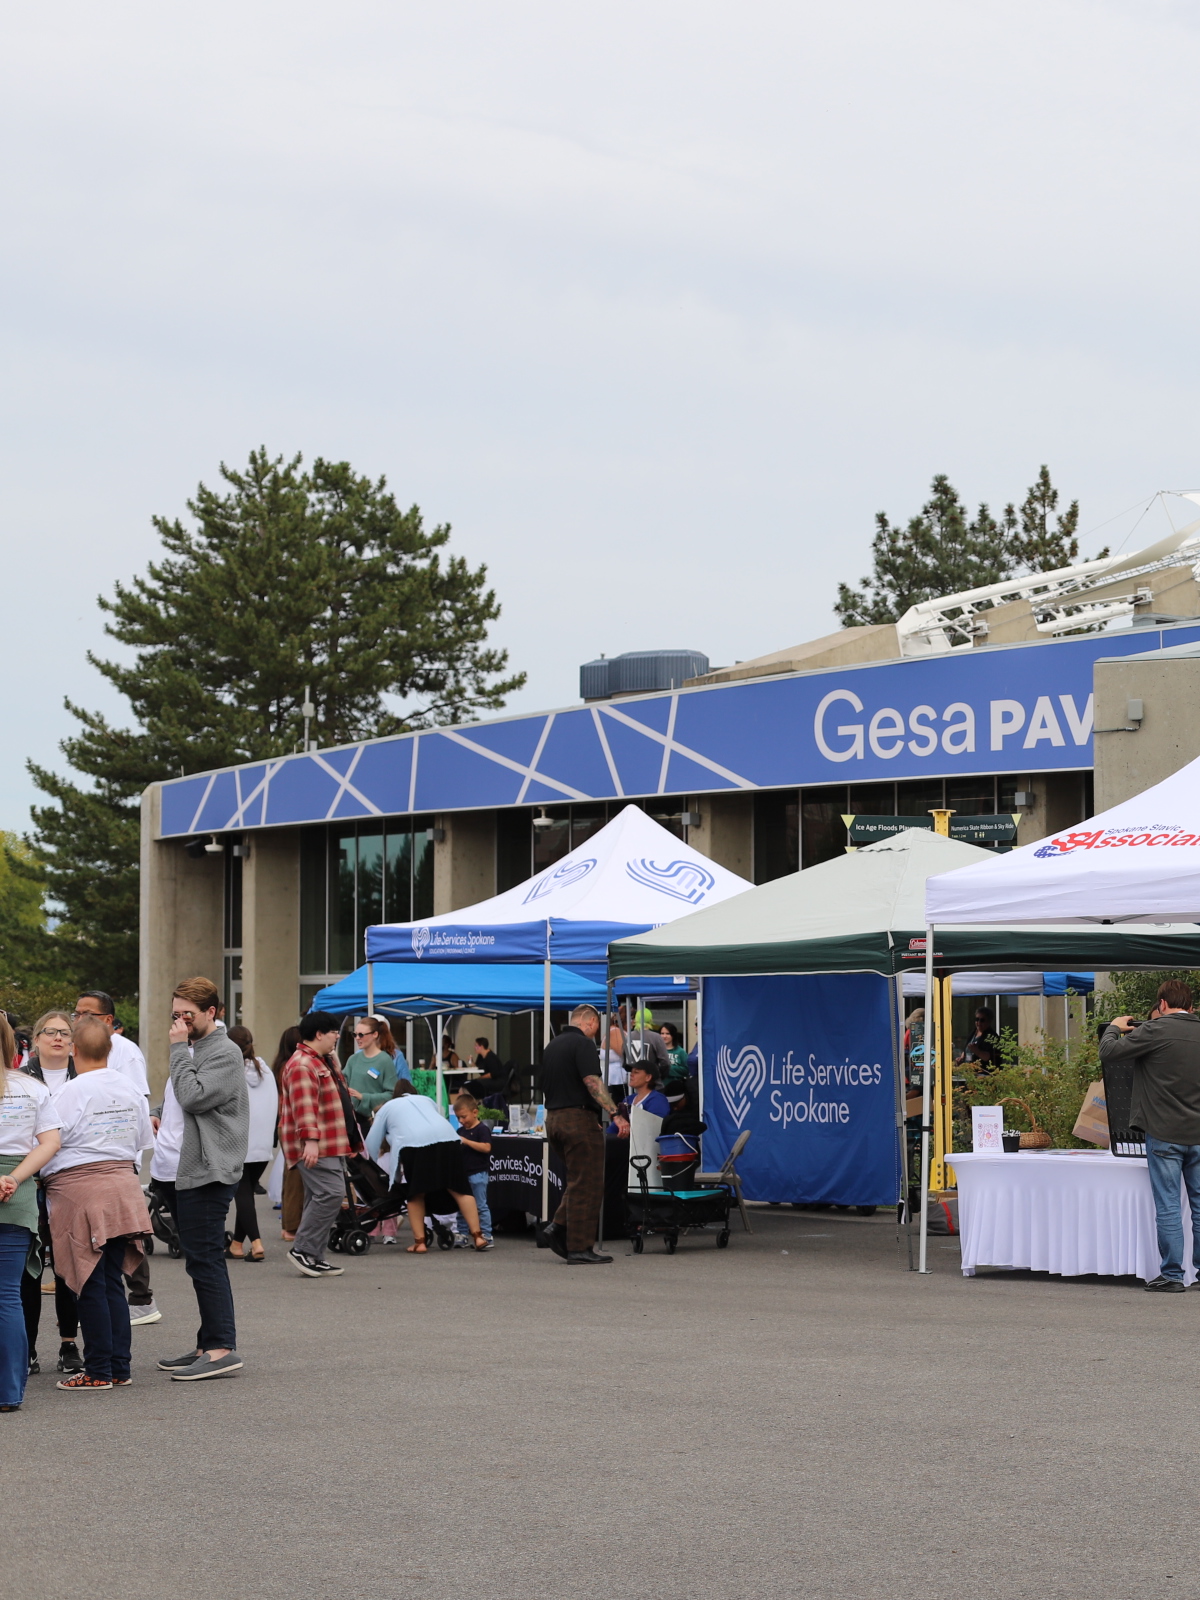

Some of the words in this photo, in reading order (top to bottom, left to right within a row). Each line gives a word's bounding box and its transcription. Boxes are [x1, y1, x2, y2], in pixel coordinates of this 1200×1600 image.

[814, 689, 975, 763] Gesa
[865, 824, 877, 832] Age
[1105, 825, 1148, 835] Spokane
[1149, 823, 1181, 832] Slavic
[429, 932, 442, 946] Life
[441, 932, 467, 946] Services
[467, 930, 495, 947] Spokane
[769, 1050, 805, 1085] Life
[808, 1053, 882, 1086] Services
[769, 1087, 850, 1130] Spokane
[489, 1155, 523, 1171] Services
[523, 1155, 563, 1189] Spoane
[498, 1174, 520, 1182] RESOURCES
[521, 1176, 537, 1187] CLINICS
